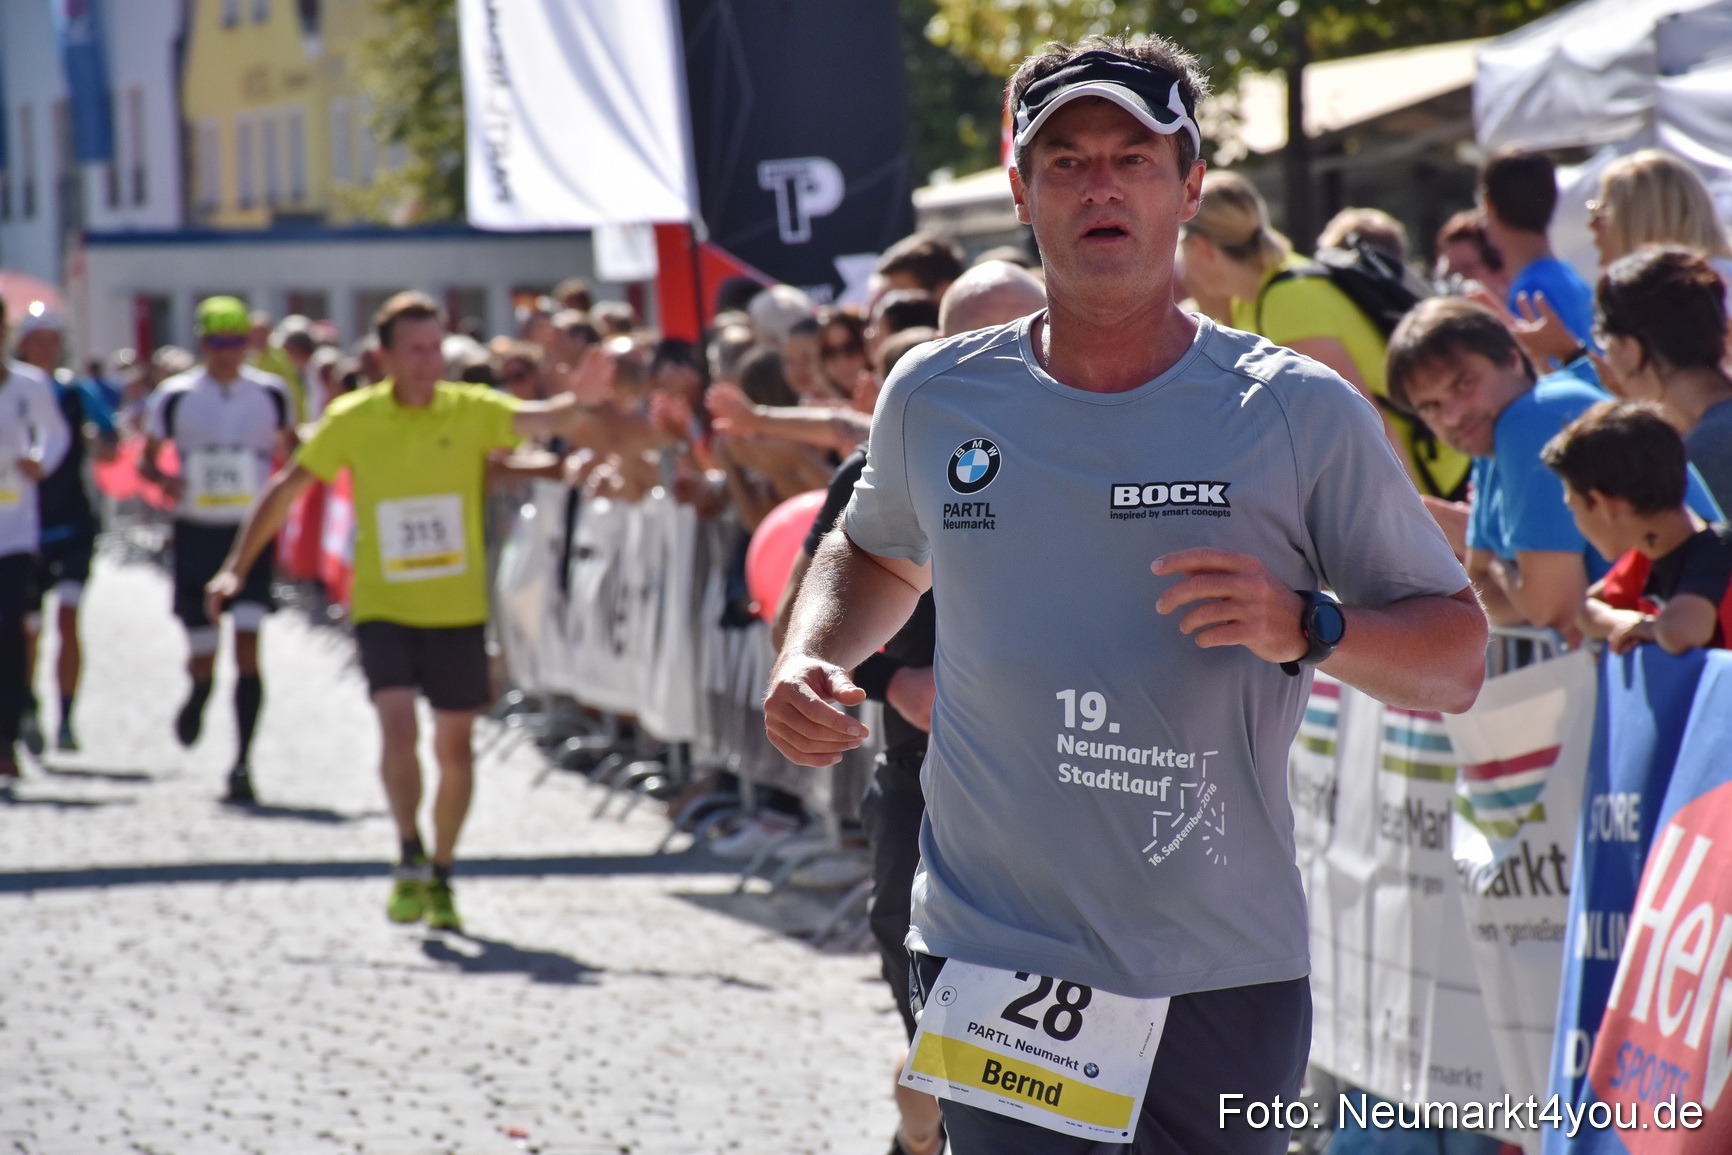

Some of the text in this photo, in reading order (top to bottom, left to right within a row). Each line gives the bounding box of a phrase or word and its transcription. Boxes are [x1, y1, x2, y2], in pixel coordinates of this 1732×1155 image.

[955, 440, 998, 459] BMW
[943, 502, 996, 518] PARTL
[1111, 482, 1231, 508] BOCK
[943, 519, 996, 530] Neumarkt
[1110, 508, 1231, 520] inspired by smart concepts
[1056, 689, 1120, 733] 19.
[1057, 734, 1196, 769] Neumarkter
[1058, 763, 1173, 802] Stadtlauf
[1161, 805, 1204, 857] September
[1200, 783, 1218, 809] 2018
[1000, 971, 1092, 1042] 28
[966, 1022, 1012, 1048] PARTL
[1014, 1038, 1079, 1072] Neumarkt
[981, 1058, 1064, 1108] Bernd
